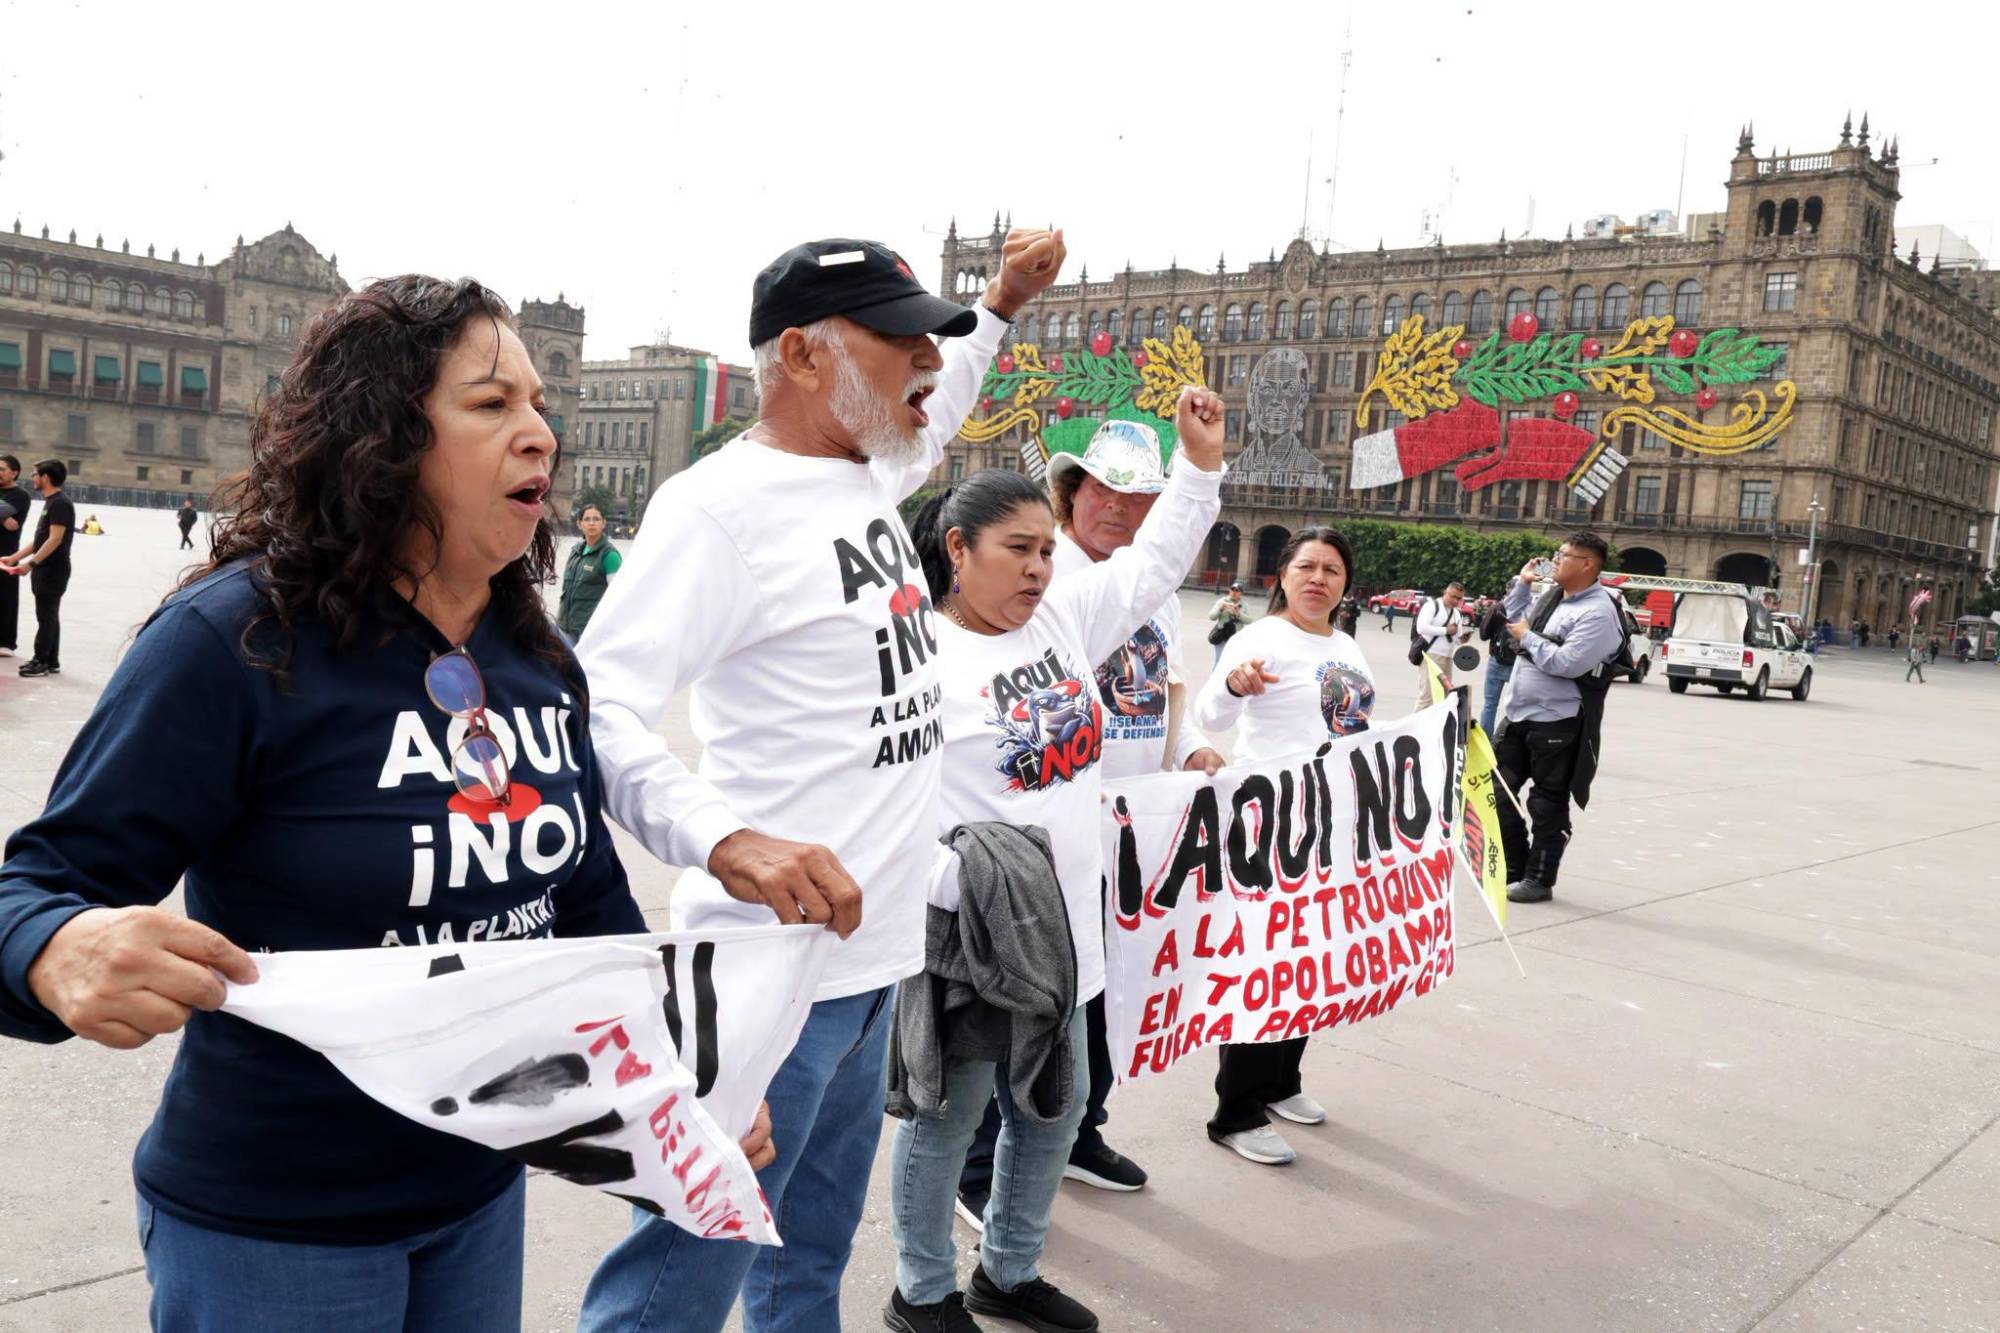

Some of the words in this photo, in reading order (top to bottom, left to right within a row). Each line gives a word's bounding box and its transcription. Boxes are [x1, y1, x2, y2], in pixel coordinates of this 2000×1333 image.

[991, 647, 1068, 717] AQUÍ
[870, 705, 887, 728] A
[895, 697, 920, 722] LA
[1104, 728, 1118, 739] SE
[1136, 715, 1157, 727] AMA
[1152, 929, 1179, 977] A
[1193, 912, 1245, 958] LA
[1139, 983, 1183, 1035] EN
[1128, 1013, 1233, 1078] FUERA
